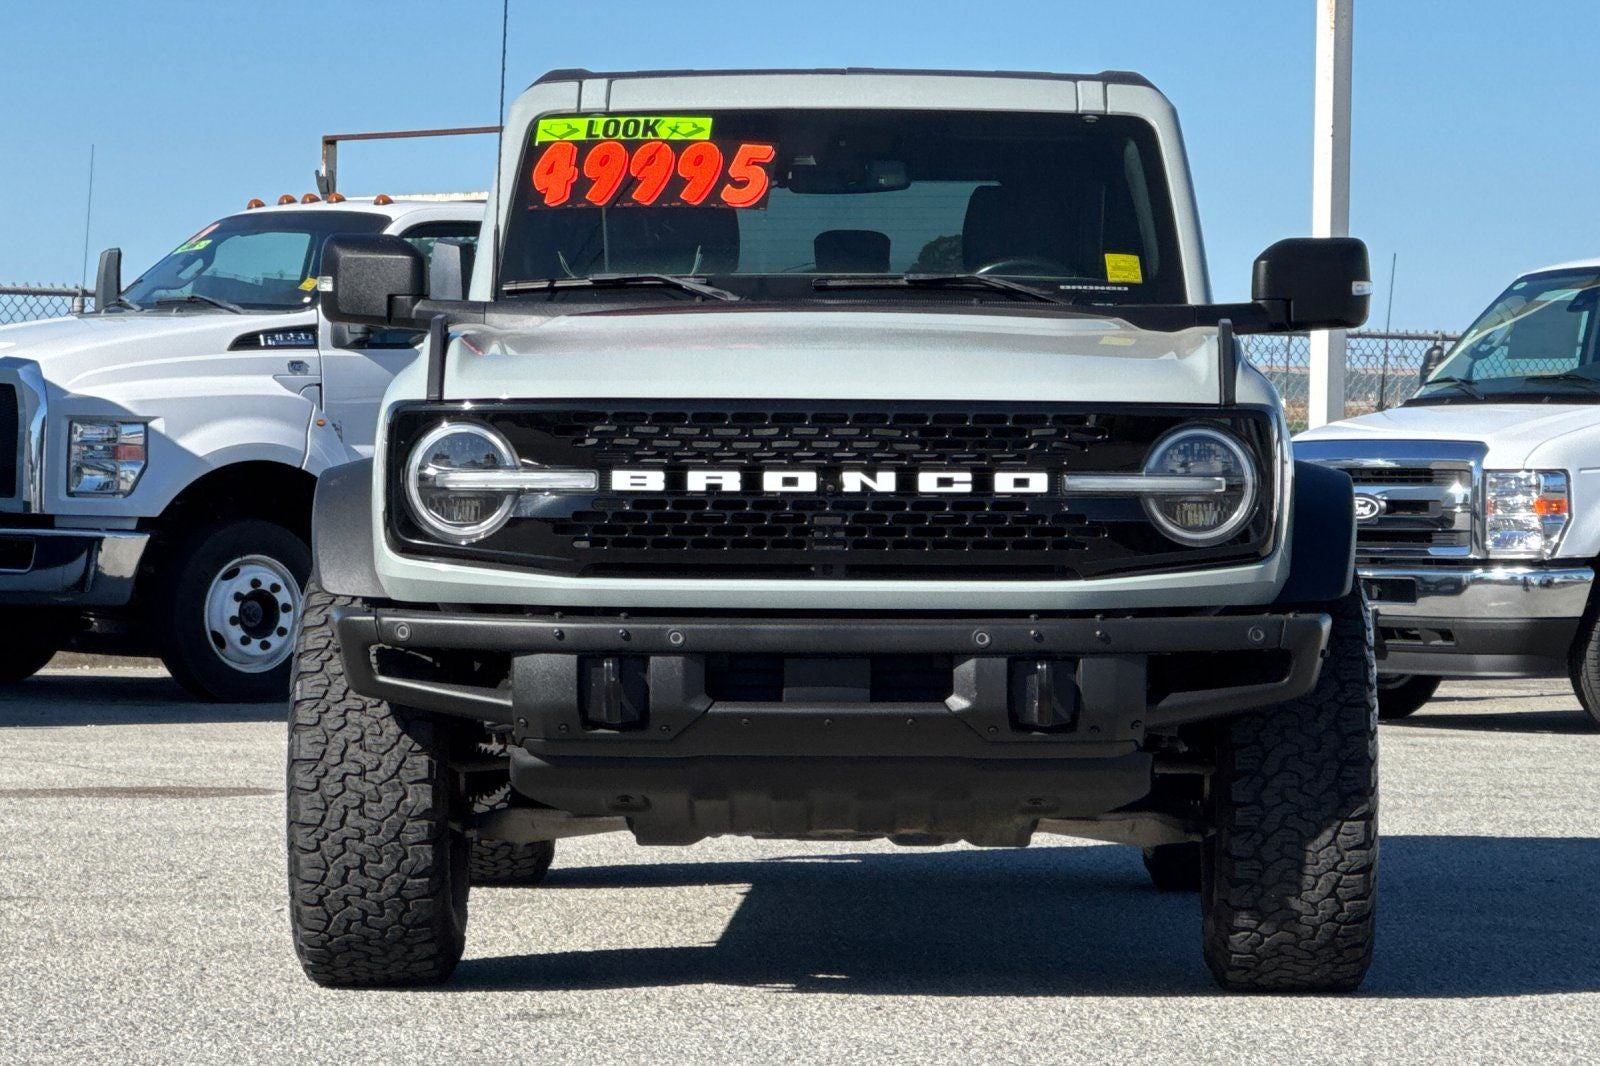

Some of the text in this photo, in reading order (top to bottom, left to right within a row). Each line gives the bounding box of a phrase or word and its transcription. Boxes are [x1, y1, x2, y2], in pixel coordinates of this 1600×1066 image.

[585, 118, 663, 139] LOOK
[532, 141, 775, 207] 49995
[611, 470, 1048, 493] BRONCO
